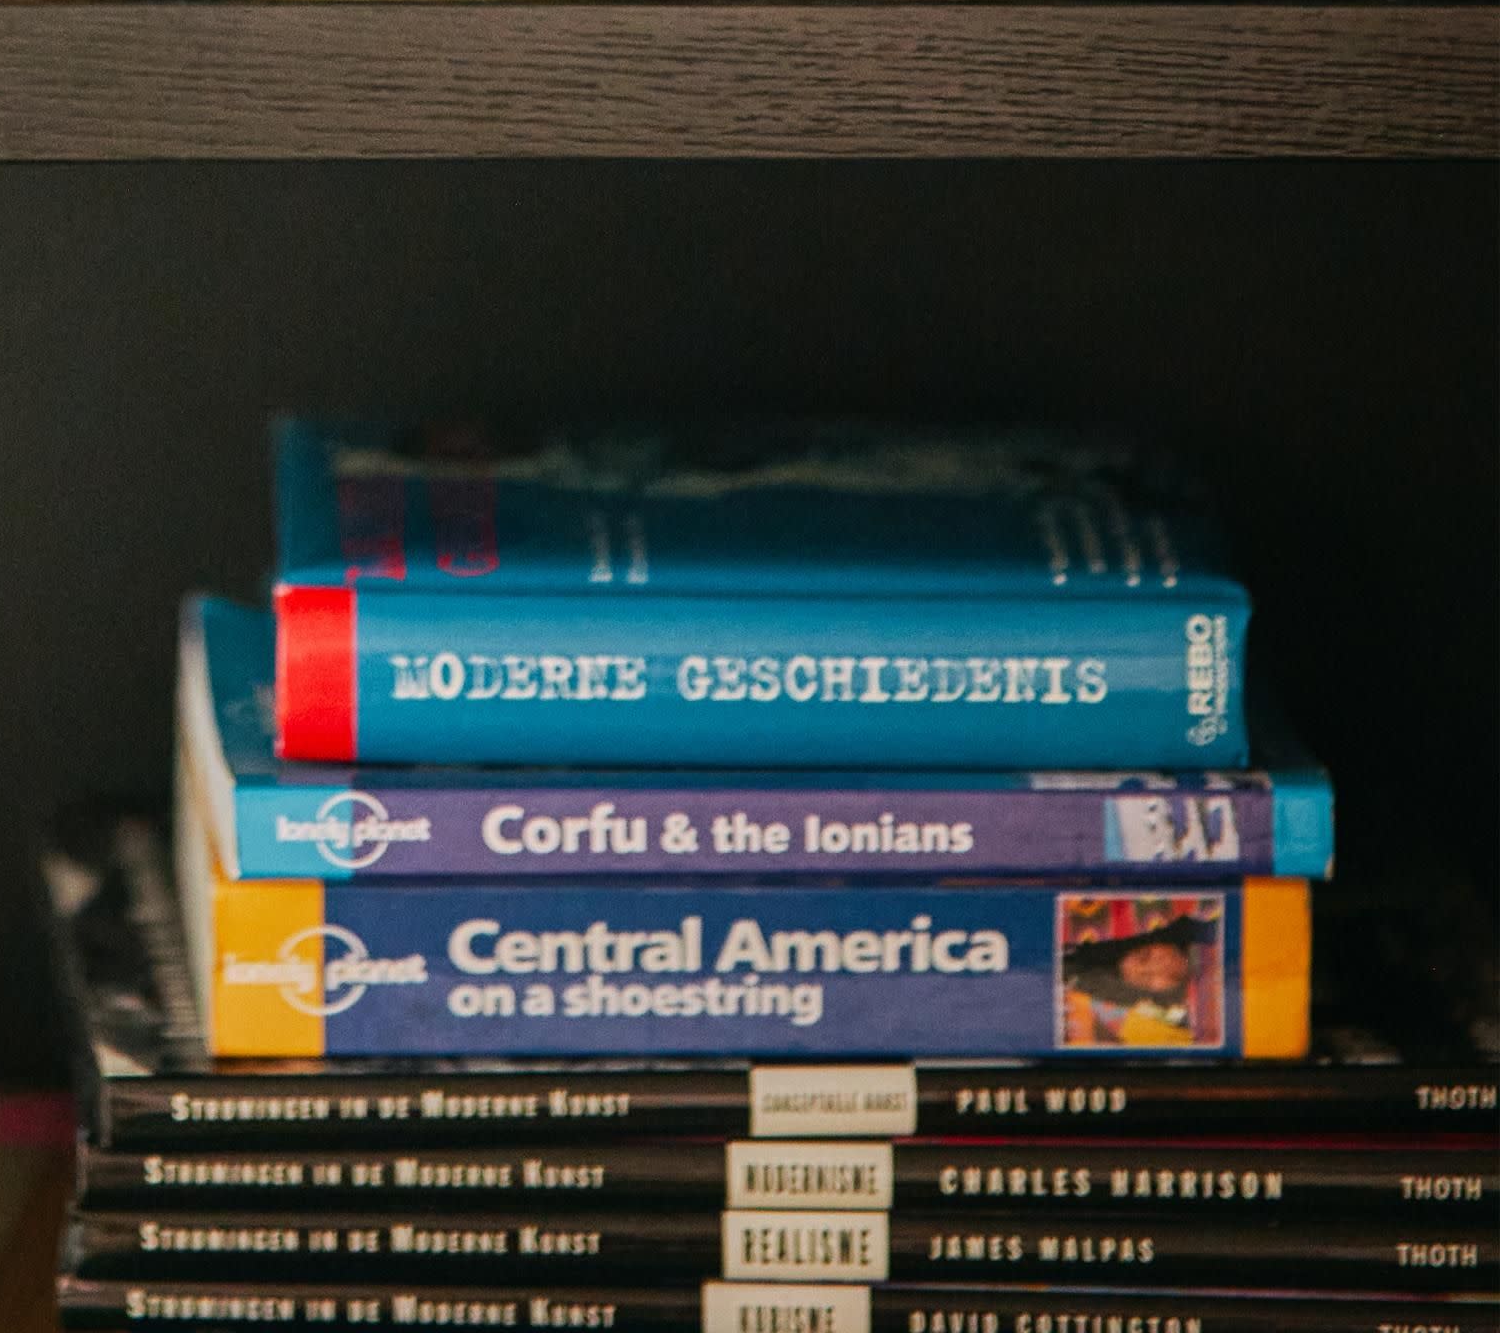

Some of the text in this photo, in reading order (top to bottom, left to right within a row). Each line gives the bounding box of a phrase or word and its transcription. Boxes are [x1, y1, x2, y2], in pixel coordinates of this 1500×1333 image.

[389, 653, 1109, 705] MODERNE GESCHIEDENIS
[1185, 613, 1214, 715] REBO
[481, 803, 974, 854] Corfu & the Ionians
[448, 915, 1010, 974] Central America
[448, 974, 824, 1026] on a shoestring
[956, 1087, 1127, 1114] PAUL WOOD
[1415, 1085, 1498, 1110] THOTH
[939, 1165, 1284, 1199] CHARLES HARRISON
[1400, 1176, 1483, 1201] THOTH
[742, 1229, 872, 1265] REALISME
[928, 1235, 1155, 1263] JAMES MALPAS
[1396, 1243, 1478, 1268] THOTH
